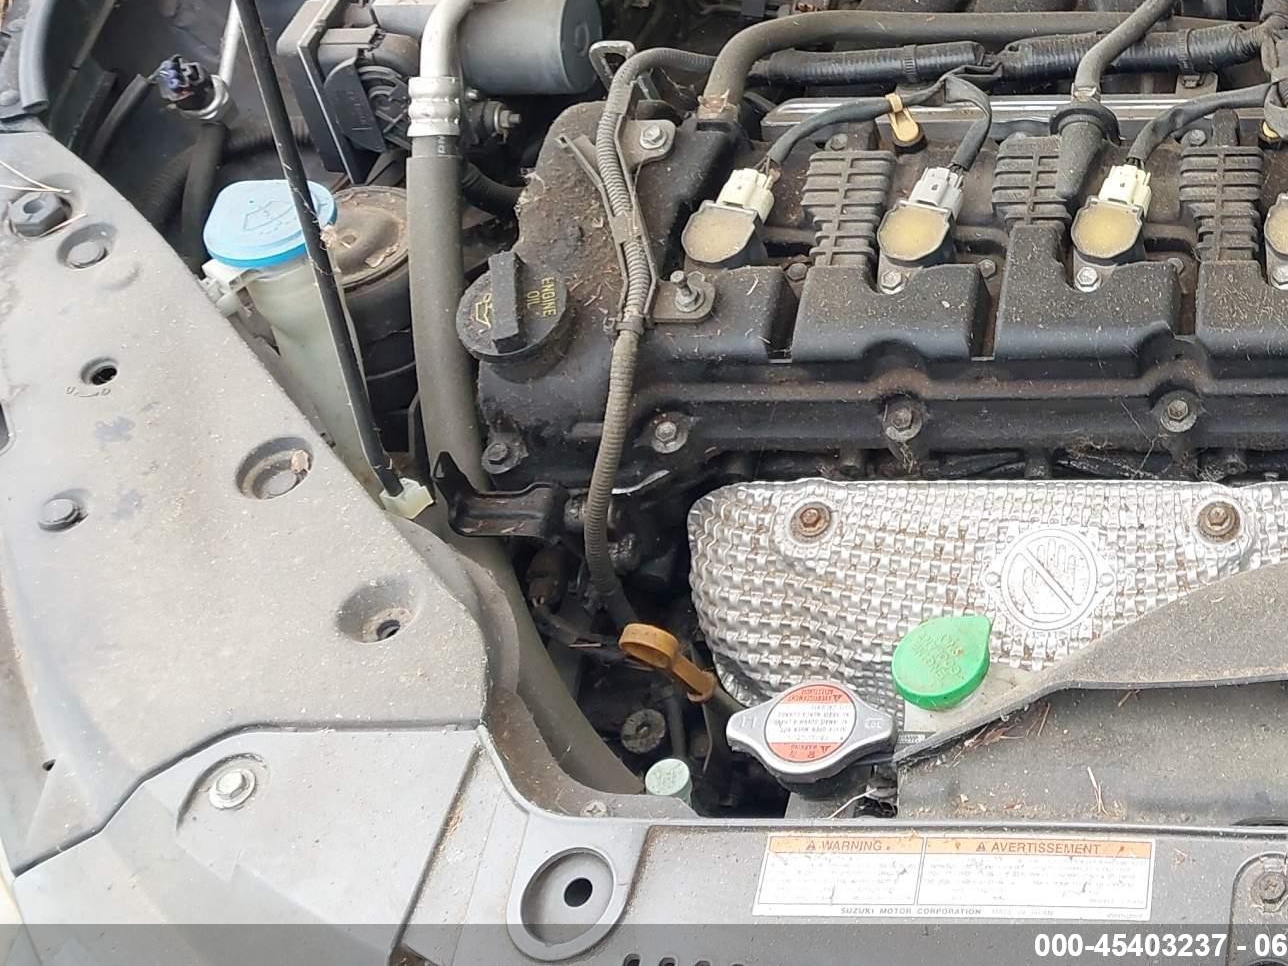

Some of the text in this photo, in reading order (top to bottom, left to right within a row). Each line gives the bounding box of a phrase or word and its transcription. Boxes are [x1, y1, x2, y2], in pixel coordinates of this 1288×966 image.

[527, 290, 540, 309] OIL
[541, 277, 556, 316] ENGINE
[822, 840, 883, 851] WARNING
[991, 842, 1101, 855] AVERTISSEMENT
[840, 907, 875, 915] SUZUKI
[879, 907, 912, 915] MOTOR
[916, 907, 982, 916] CORPORATION
